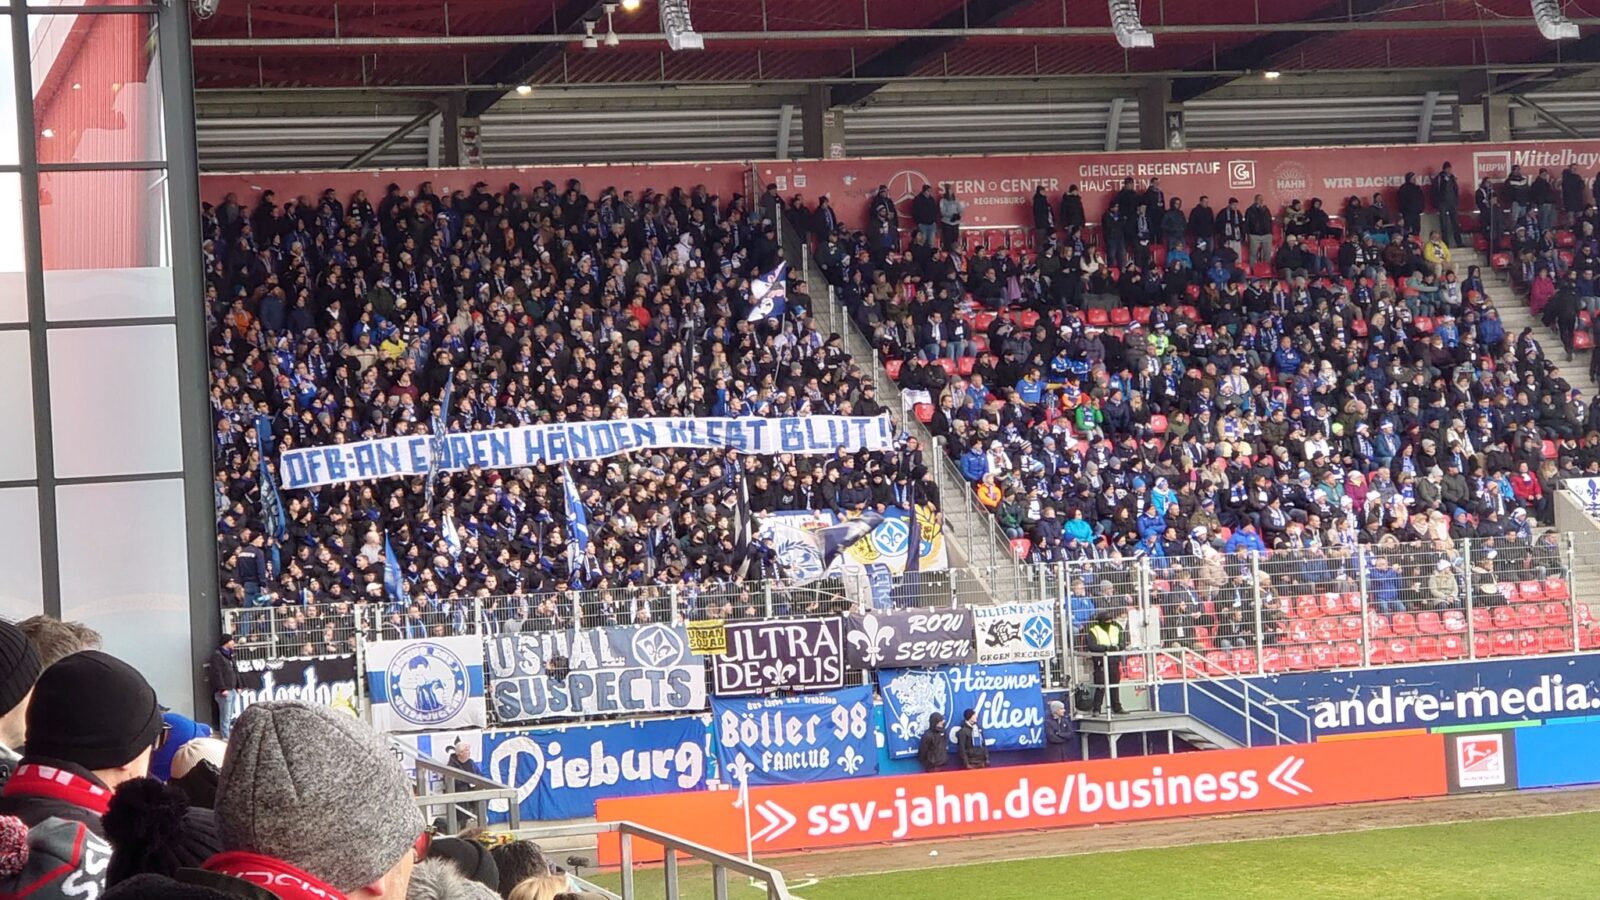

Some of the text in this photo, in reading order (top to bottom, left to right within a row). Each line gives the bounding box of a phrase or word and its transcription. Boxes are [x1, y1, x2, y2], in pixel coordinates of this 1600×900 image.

[1514, 149, 1600, 169] Mittelbay
[1079, 162, 1221, 177] GIENGER REGENSTAUF
[1000, 178, 1060, 192] CENTER
[1276, 179, 1306, 189] HAHN
[1323, 177, 1352, 188] WIR
[973, 197, 1026, 206] REGENSBURG
[779, 416, 887, 452] BLUT!
[908, 614, 964, 634] ROW
[688, 628, 724, 639] URBAN
[689, 637, 725, 648] SQUAD
[895, 644, 970, 661] SEVEN
[980, 652, 1010, 662] GEGEN
[718, 656, 840, 690] DE LIS
[950, 667, 1040, 693] Häzemer
[494, 667, 692, 720] SUSPECTS
[721, 701, 867, 748] Böller 98
[1019, 728, 1042, 745] e.V.
[762, 747, 830, 773] FANCLUB
[488, 736, 703, 812] Dieburg
[807, 767, 1259, 838] ssv-jahn.de/business
